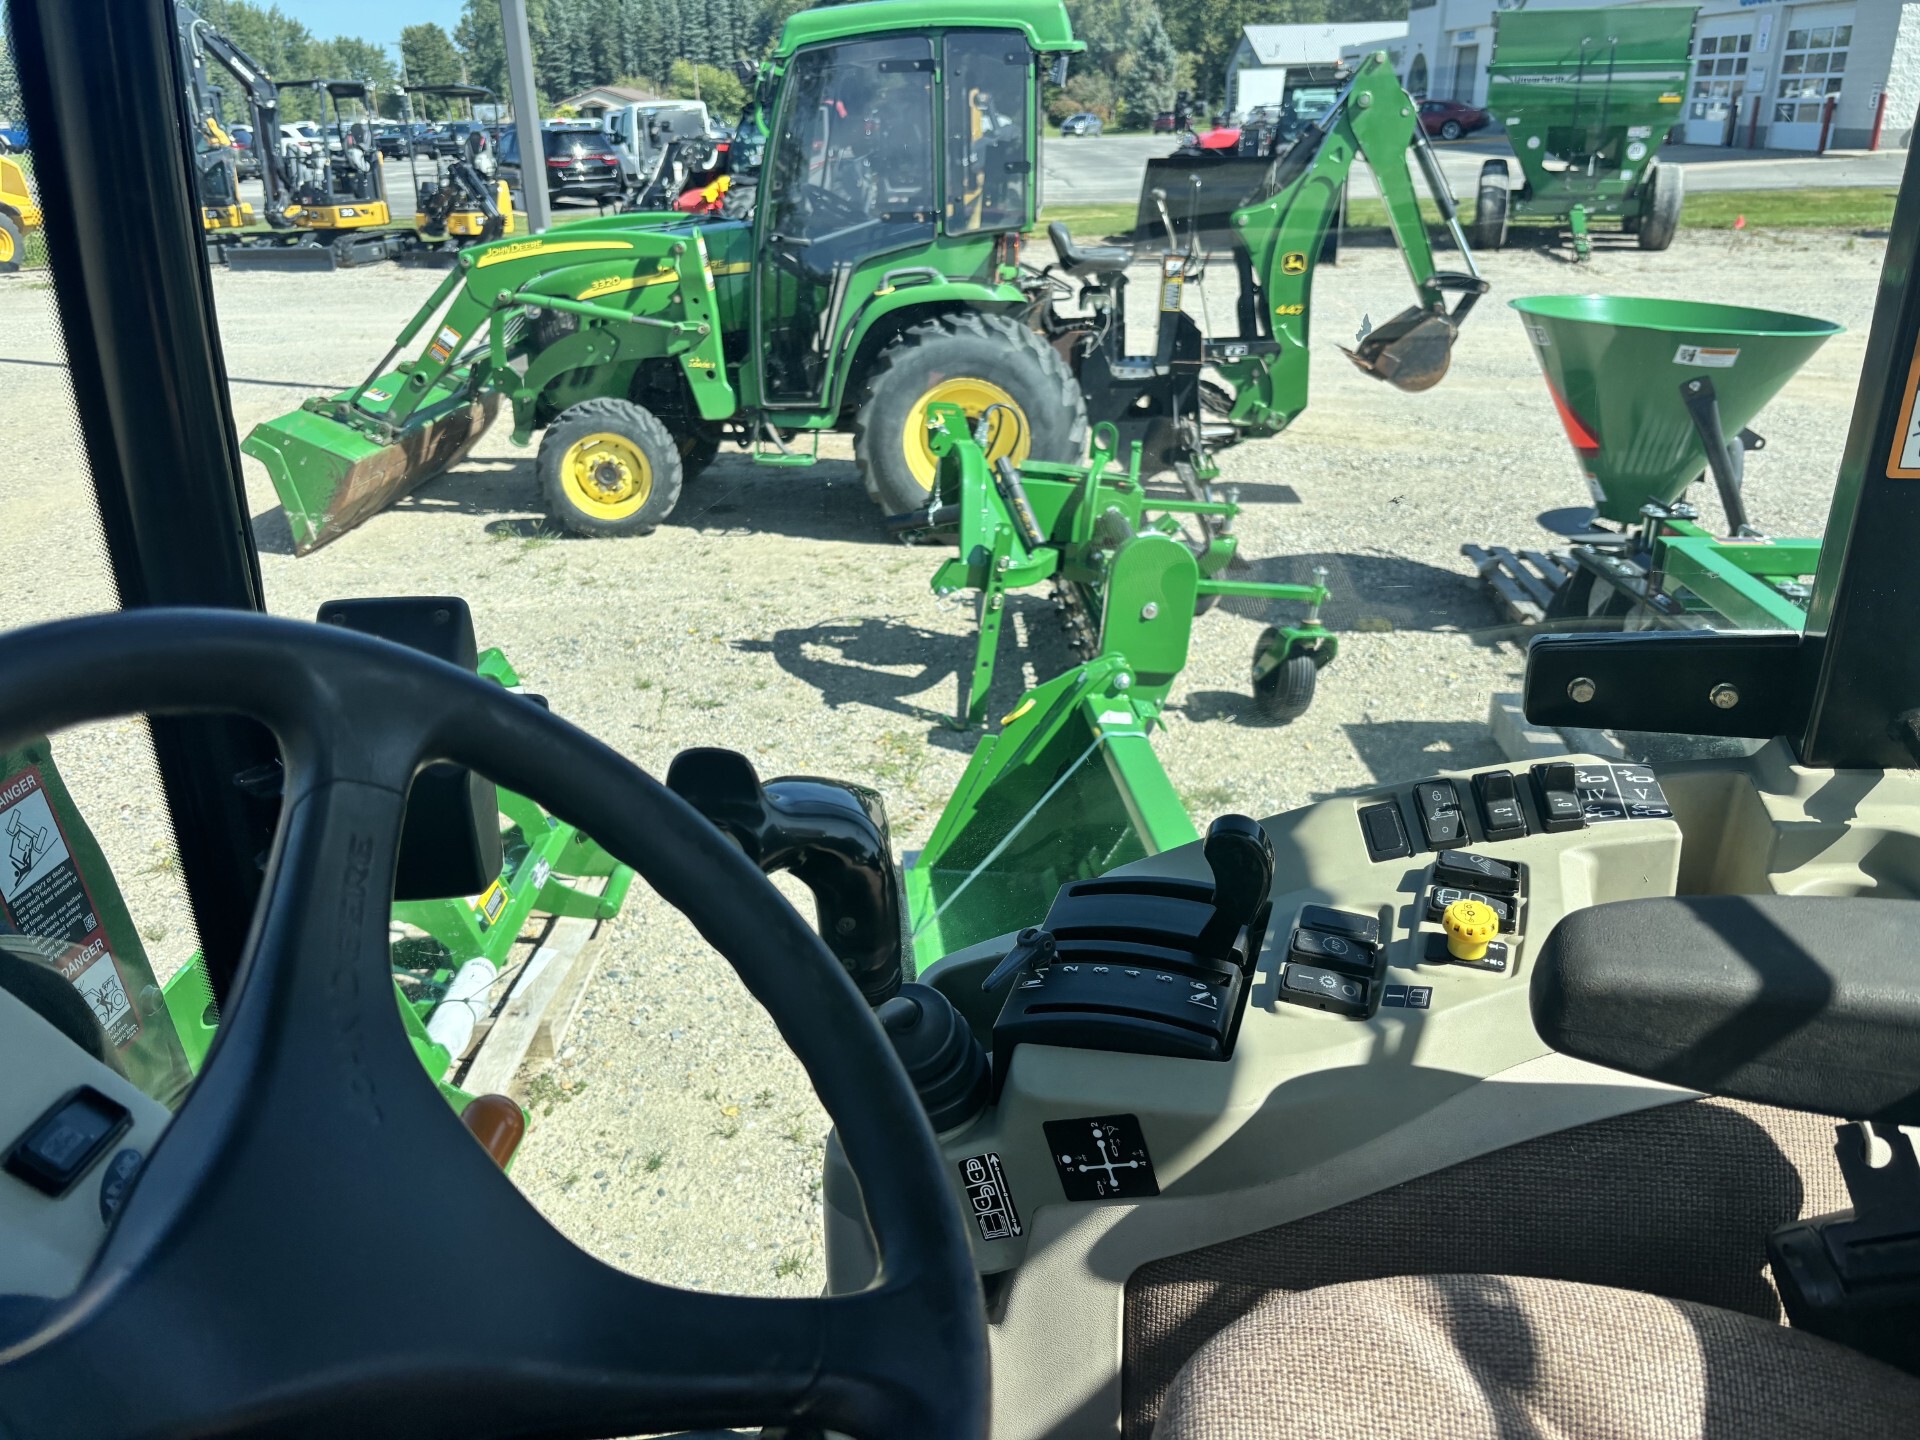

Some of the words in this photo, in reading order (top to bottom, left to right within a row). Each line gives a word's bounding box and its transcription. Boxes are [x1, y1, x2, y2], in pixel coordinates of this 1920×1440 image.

[486, 247, 511, 259] JOHN
[510, 240, 543, 254] DEERE
[591, 275, 621, 292] 3320
[1275, 304, 1305, 316] 447
[0, 775, 37, 809] ANGER
[1585, 788, 1606, 801] IV
[1633, 788, 1649, 801] V
[12, 891, 32, 909] Serious
[51, 866, 66, 879] death
[16, 906, 26, 917] can
[26, 895, 41, 909] result
[39, 886, 52, 899] from
[19, 914, 30, 926] Use
[29, 901, 45, 917] ROPS
[44, 894, 55, 906] and
[54, 879, 73, 897] seatbelt
[37, 912, 57, 933] required
[56, 905, 67, 916] rear
[43, 921, 60, 937] wheels
[65, 903, 81, 919] widest
[37, 925, 67, 951] commended
[1063, 965, 1078, 973] 2
[1093, 966, 1109, 974] 3
[1125, 969, 1141, 977] 4
[1156, 974, 1173, 983] 5
[1189, 981, 1207, 990] 6
